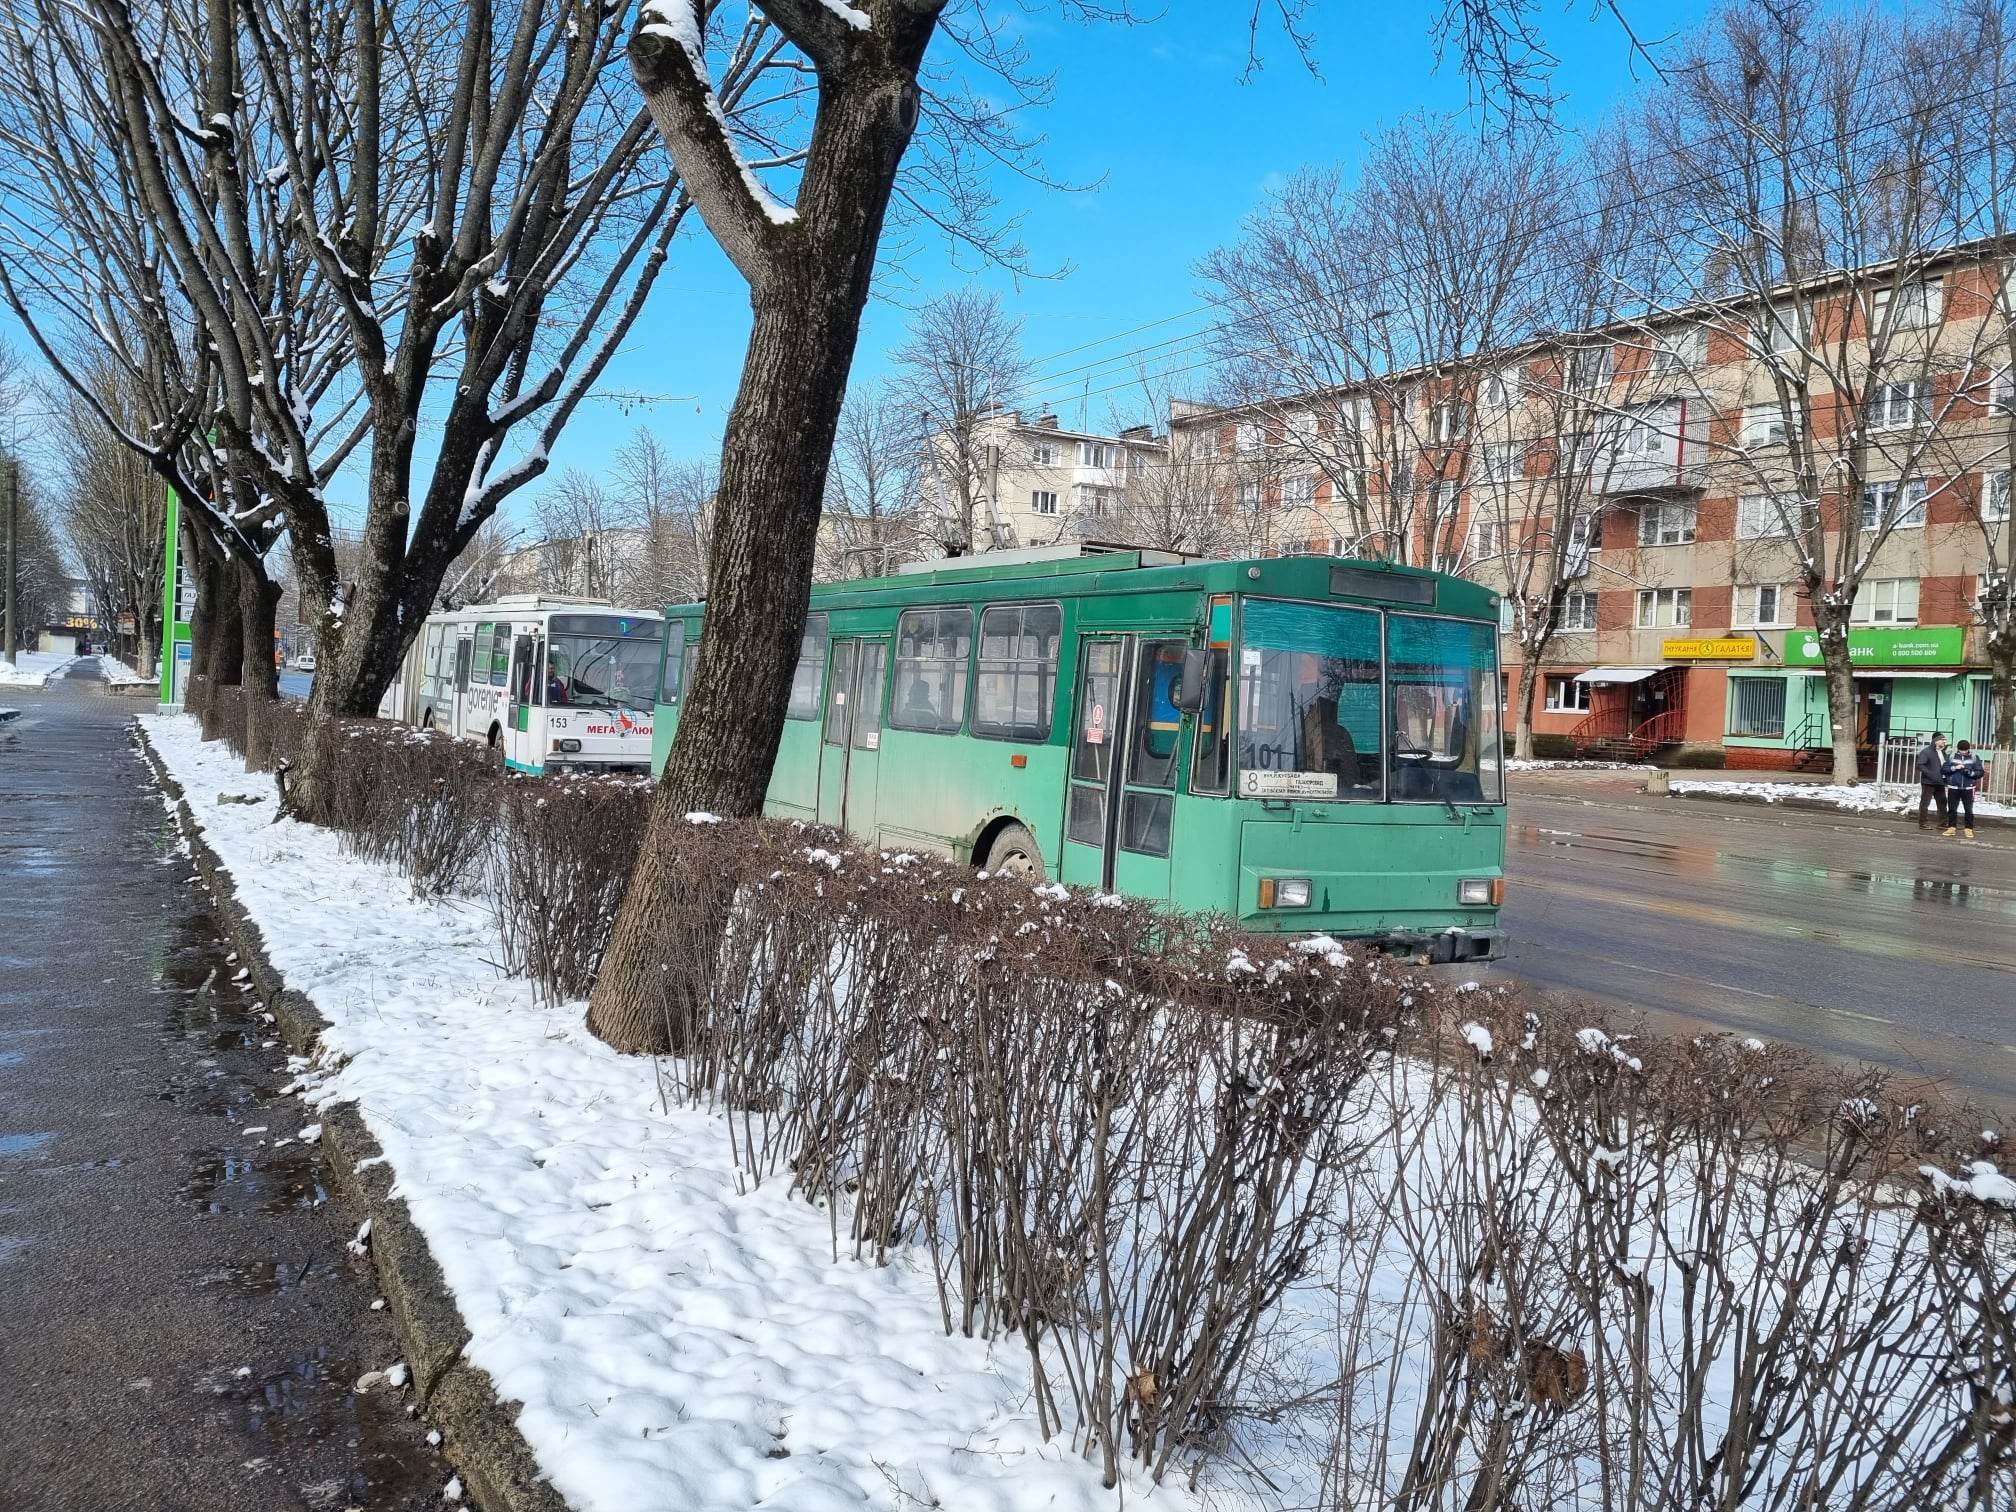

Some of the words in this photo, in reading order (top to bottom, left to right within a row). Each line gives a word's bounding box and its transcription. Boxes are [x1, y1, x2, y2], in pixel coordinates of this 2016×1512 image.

[467, 686, 499, 718] gorenje
[550, 717, 568, 729] 153
[587, 725, 616, 734] МЕГА
[1245, 743, 1282, 769] 101
[1247, 772, 1258, 793] 8
